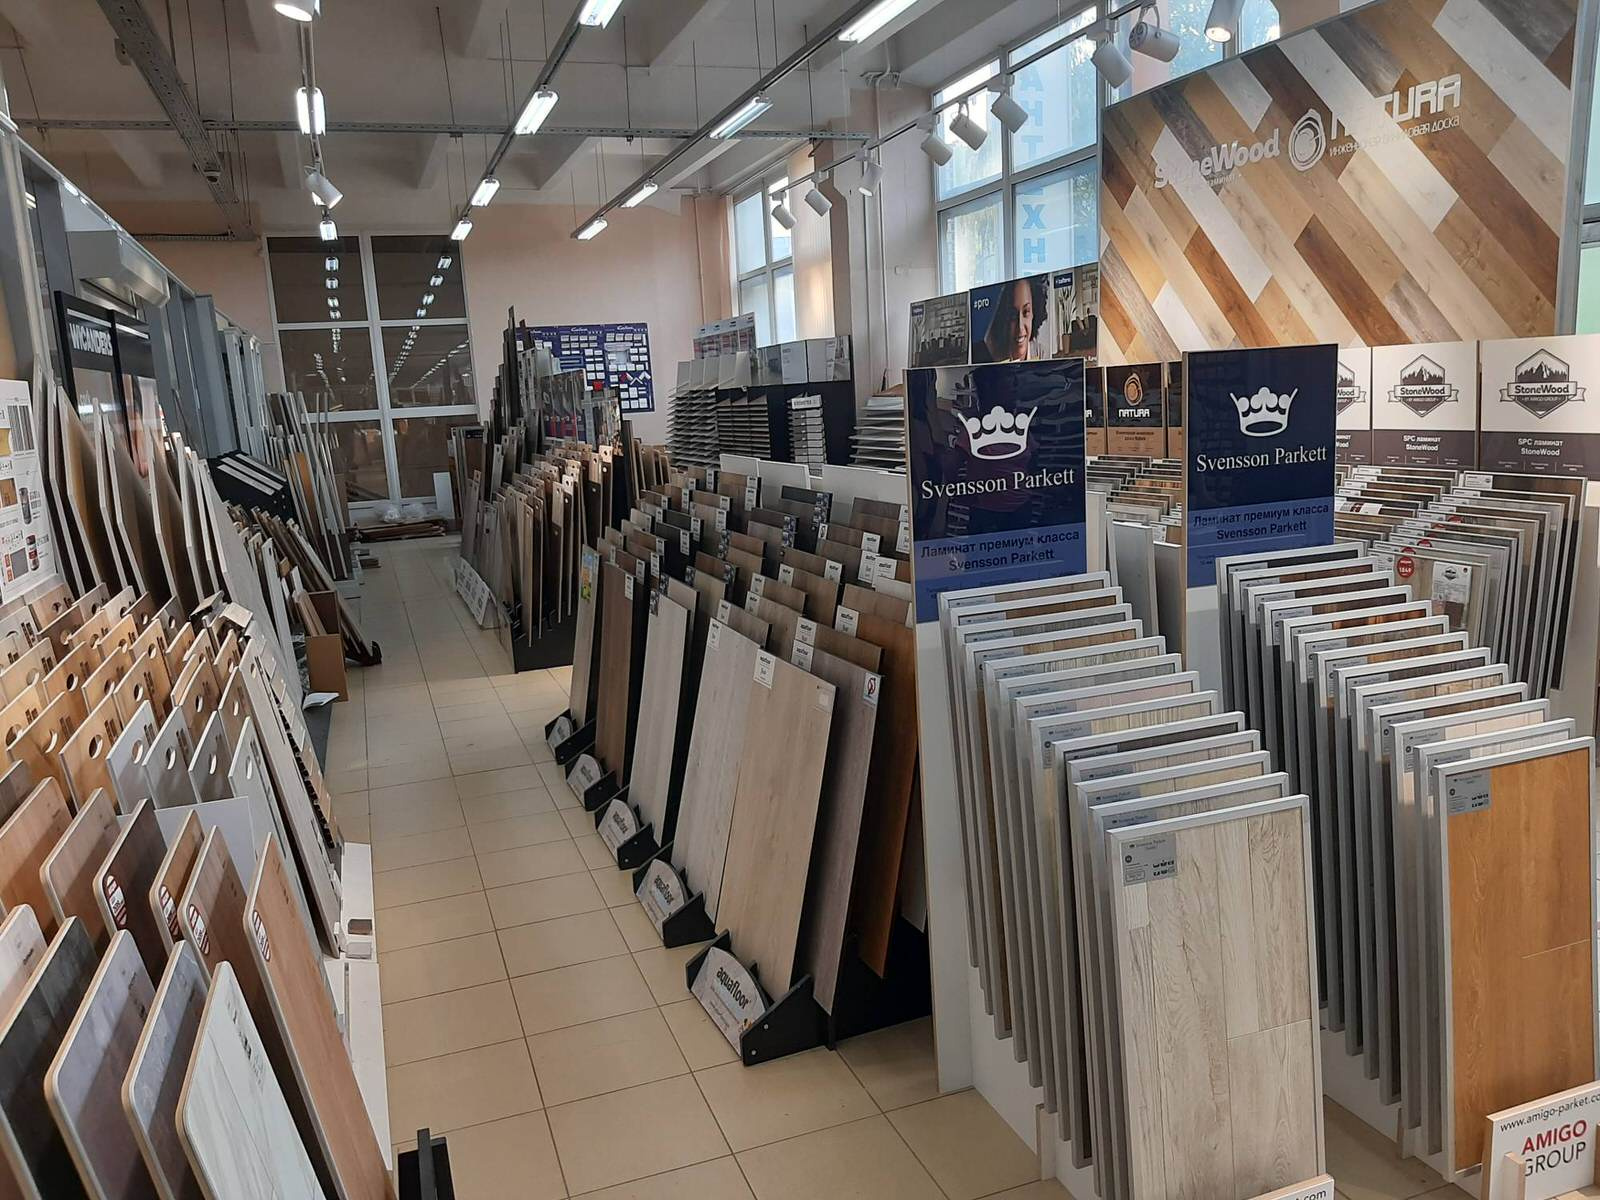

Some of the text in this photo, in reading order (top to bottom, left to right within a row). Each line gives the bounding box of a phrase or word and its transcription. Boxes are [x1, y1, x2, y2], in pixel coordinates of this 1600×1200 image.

[69, 322, 113, 357] WICANDERS
[1400, 386, 1446, 395] StoneWood
[1514, 383, 1569, 394] StoneWood
[1118, 408, 1151, 418] NATURA
[1405, 443, 1439, 451] StoneWood
[1518, 438, 1533, 446] SPC
[1521, 447, 1561, 456] StoneWood
[1196, 446, 1328, 472] Svensson Parkett
[921, 467, 1075, 500] Svensson Parkett
[1243, 506, 1290, 522] премиум
[1292, 503, 1329, 516] класса
[1216, 521, 1307, 540] Svensson Parkett
[921, 530, 1080, 559] Ламинат премиум класса
[949, 549, 1055, 571] Svensson Parkett
[716, 966, 749, 1009] aquafloor
[1521, 1119, 1587, 1155] AMIGO
[1525, 1142, 1586, 1177] GROUP
